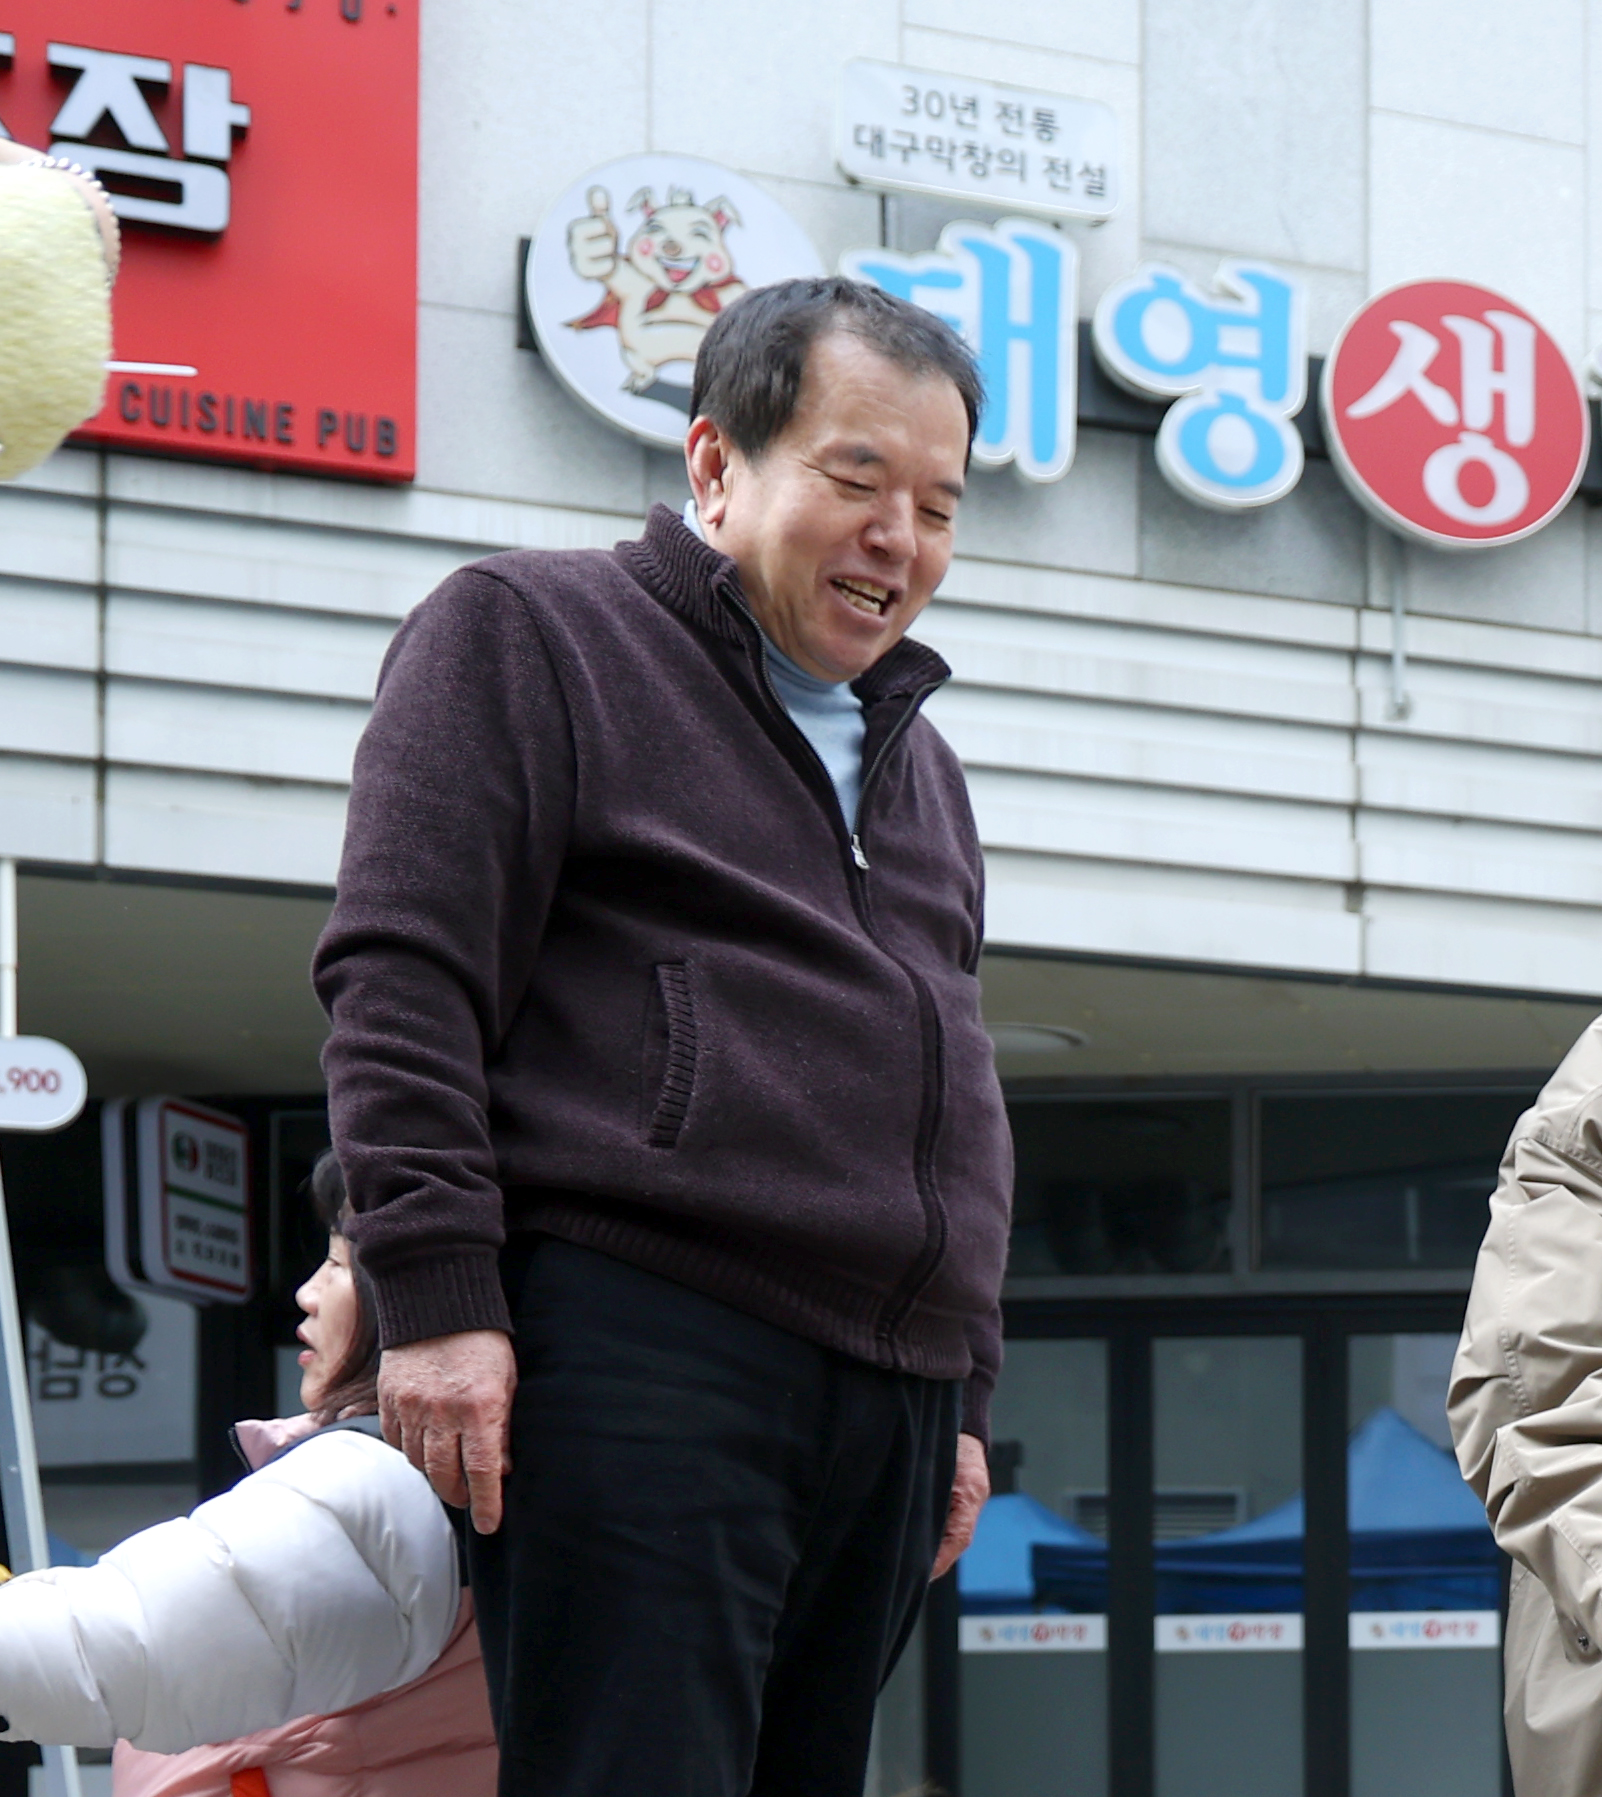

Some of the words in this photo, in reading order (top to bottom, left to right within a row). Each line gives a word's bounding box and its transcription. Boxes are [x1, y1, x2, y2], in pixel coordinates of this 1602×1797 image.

[0, 33, 251, 234] 잠
[901, 84, 980, 129] 30년
[995, 100, 1060, 143] 전통
[852, 123, 1027, 183] 대구막창의
[1042, 155, 1106, 197] 전설
[120, 382, 295, 444] CUISINE
[317, 408, 399, 457] PUB
